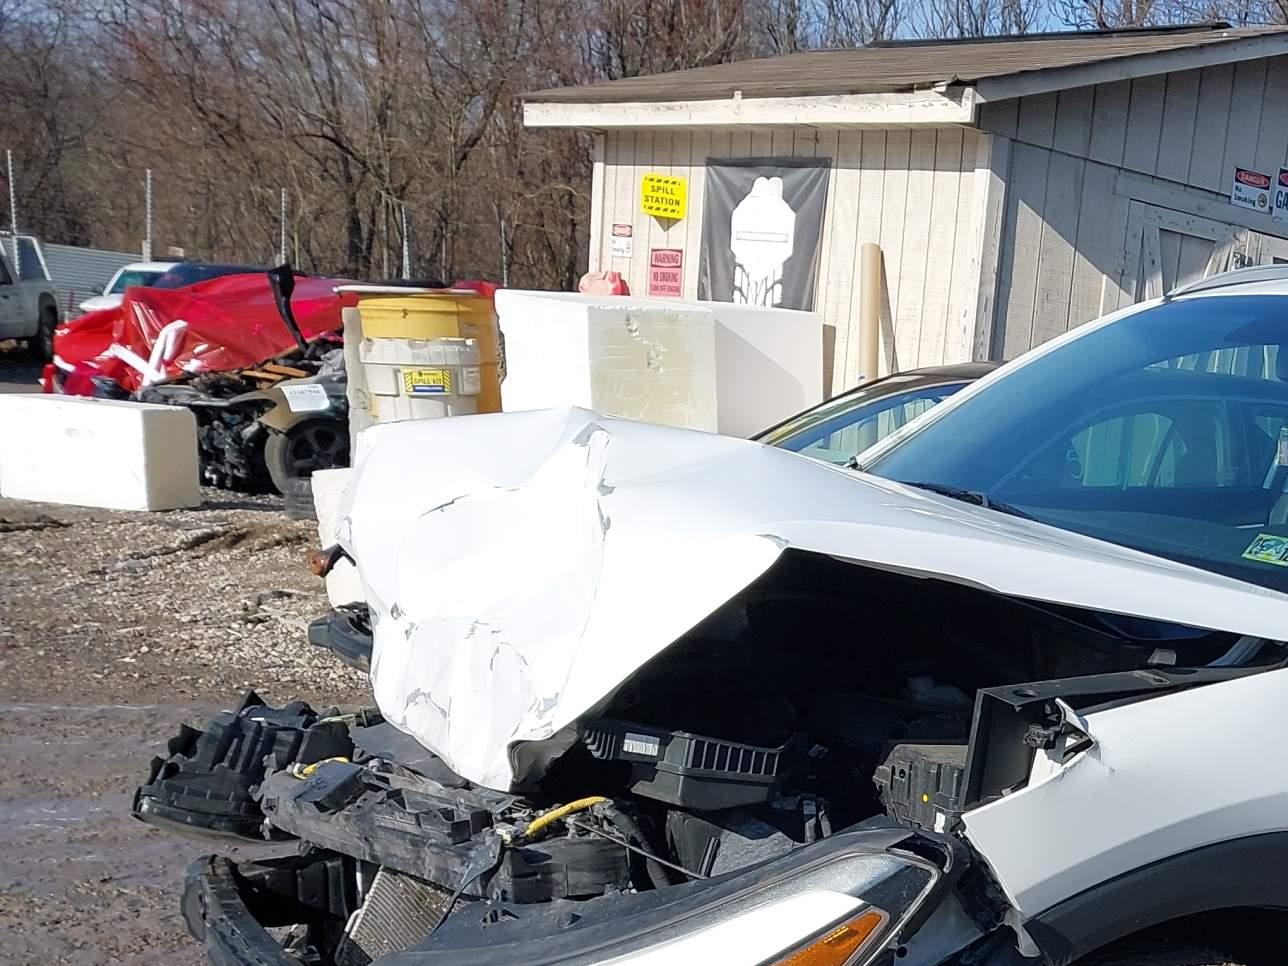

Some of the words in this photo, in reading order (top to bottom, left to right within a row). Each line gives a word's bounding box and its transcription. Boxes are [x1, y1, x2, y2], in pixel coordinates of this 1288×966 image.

[1239, 173, 1266, 185] DANGER
[650, 185, 675, 195] SPILL
[644, 195, 680, 207] STATION
[1234, 194, 1256, 207] Smoking
[654, 253, 679, 264] WARNING
[1248, 537, 1269, 554] 25
